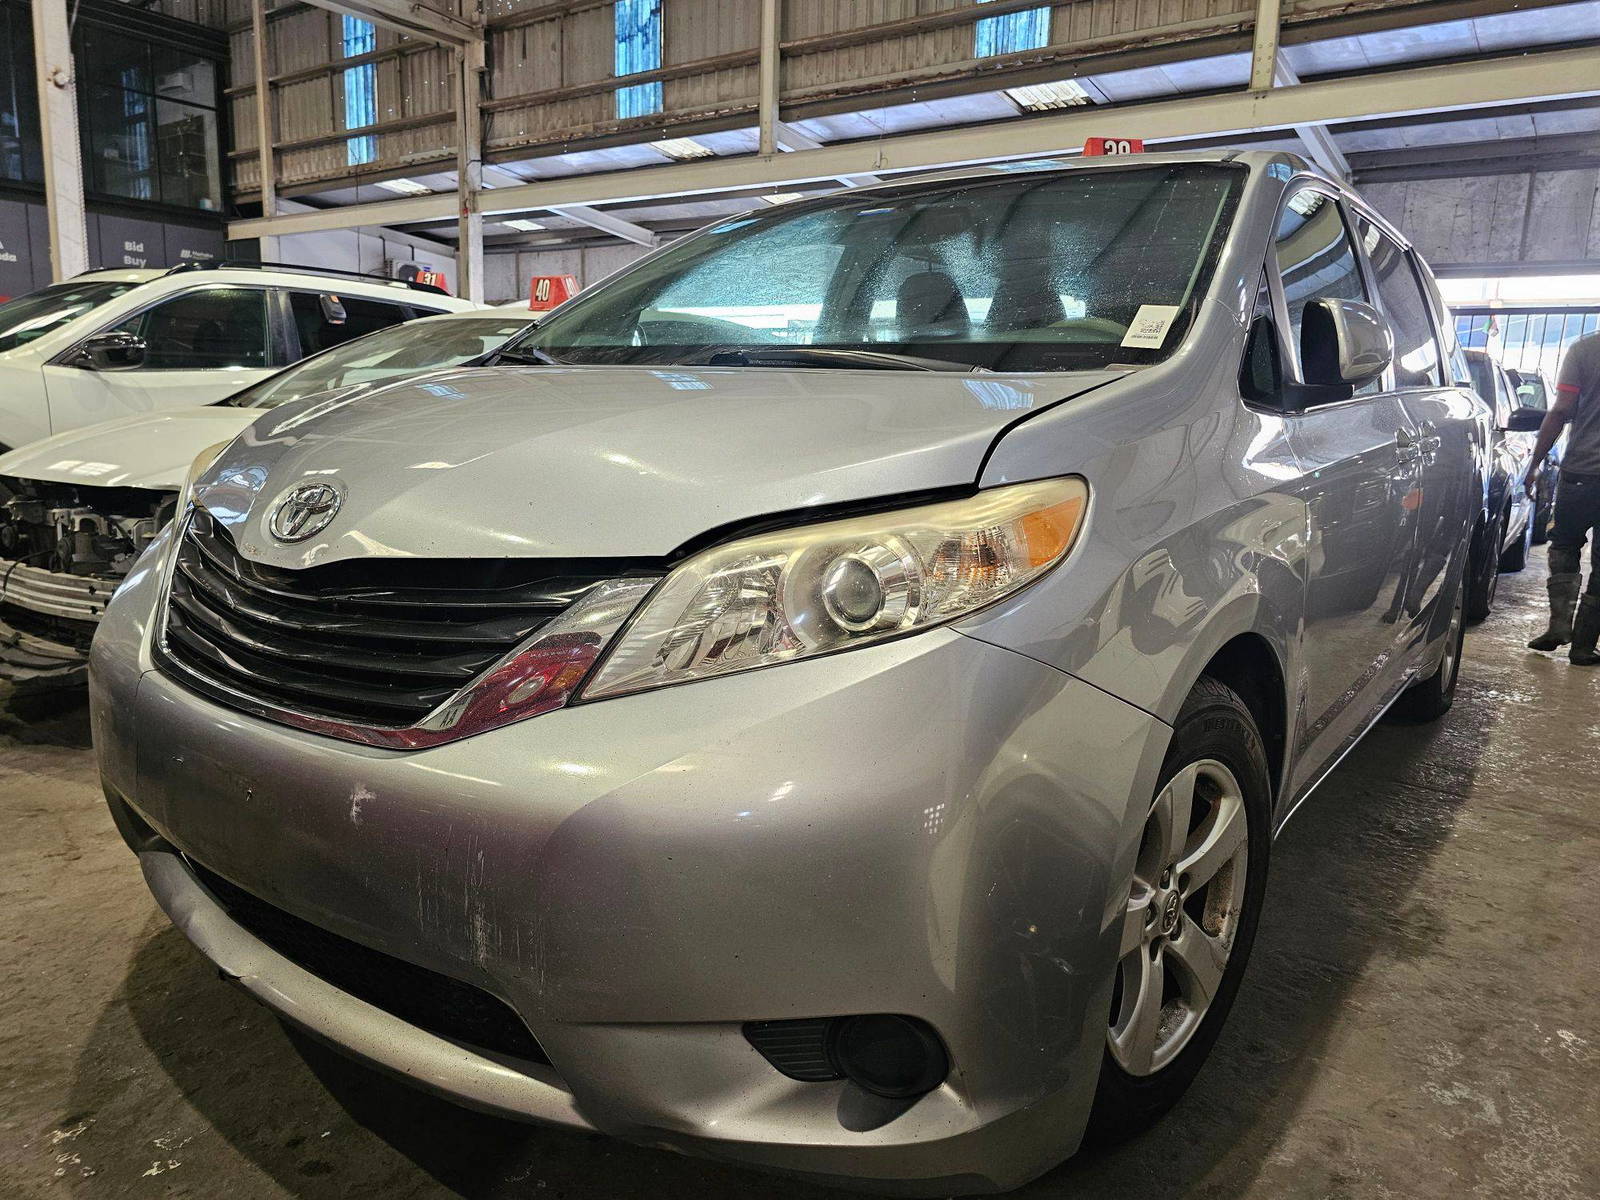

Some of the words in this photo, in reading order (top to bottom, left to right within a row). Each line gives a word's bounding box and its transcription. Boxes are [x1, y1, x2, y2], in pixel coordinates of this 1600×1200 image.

[124, 240, 145, 252] Bid
[123, 254, 147, 268] Buy
[423, 272, 437, 286] 31
[535, 279, 550, 301] 40
